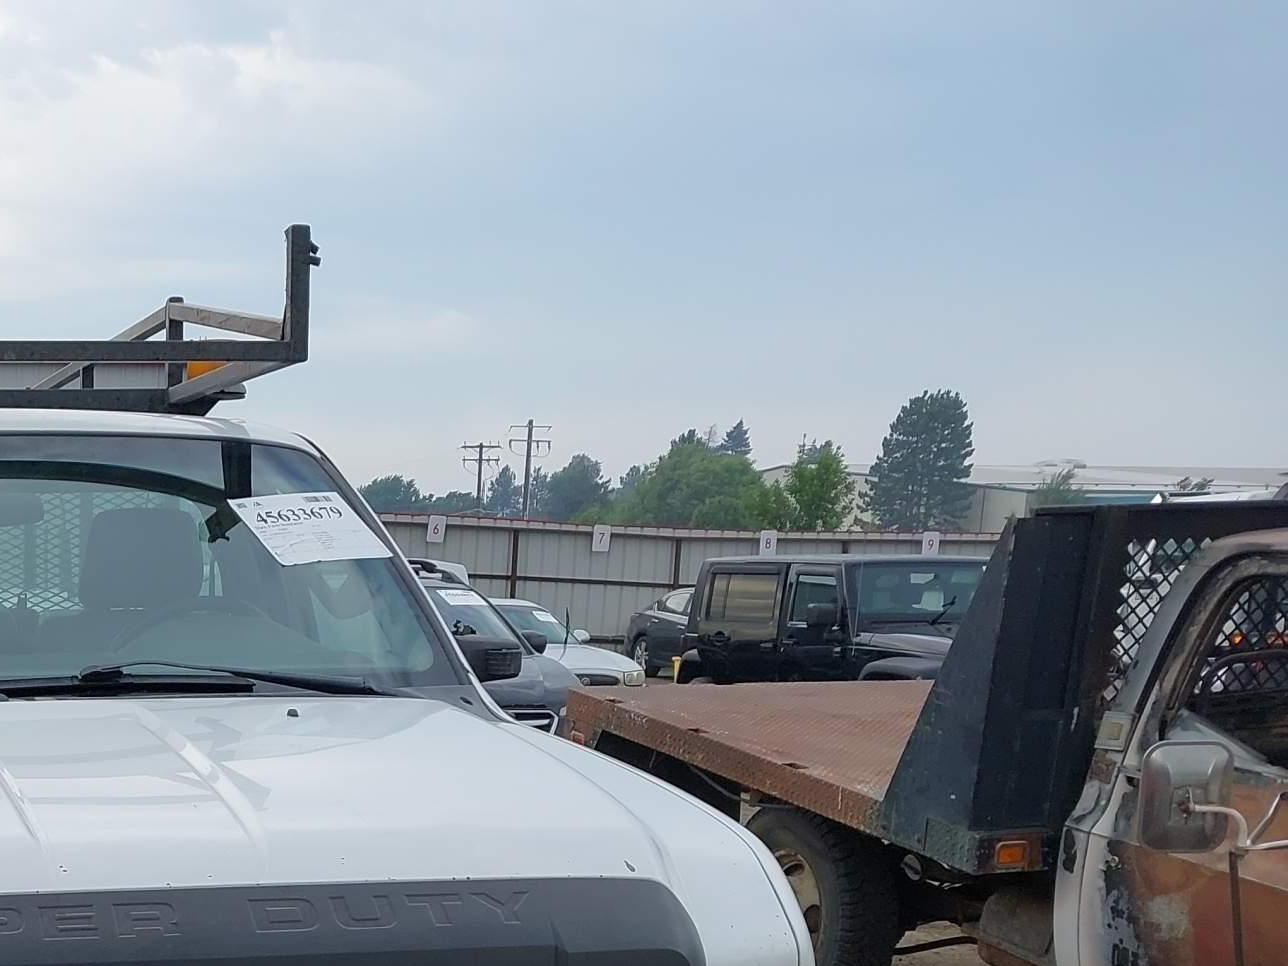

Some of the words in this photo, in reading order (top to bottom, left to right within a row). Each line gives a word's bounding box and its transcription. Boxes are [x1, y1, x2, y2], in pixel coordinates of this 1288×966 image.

[255, 505, 344, 525] 45633679
[432, 523, 440, 535] 6
[599, 532, 607, 545] 7
[765, 537, 772, 550] 8
[927, 539, 934, 551] 9
[247, 890, 530, 933] DUTY
